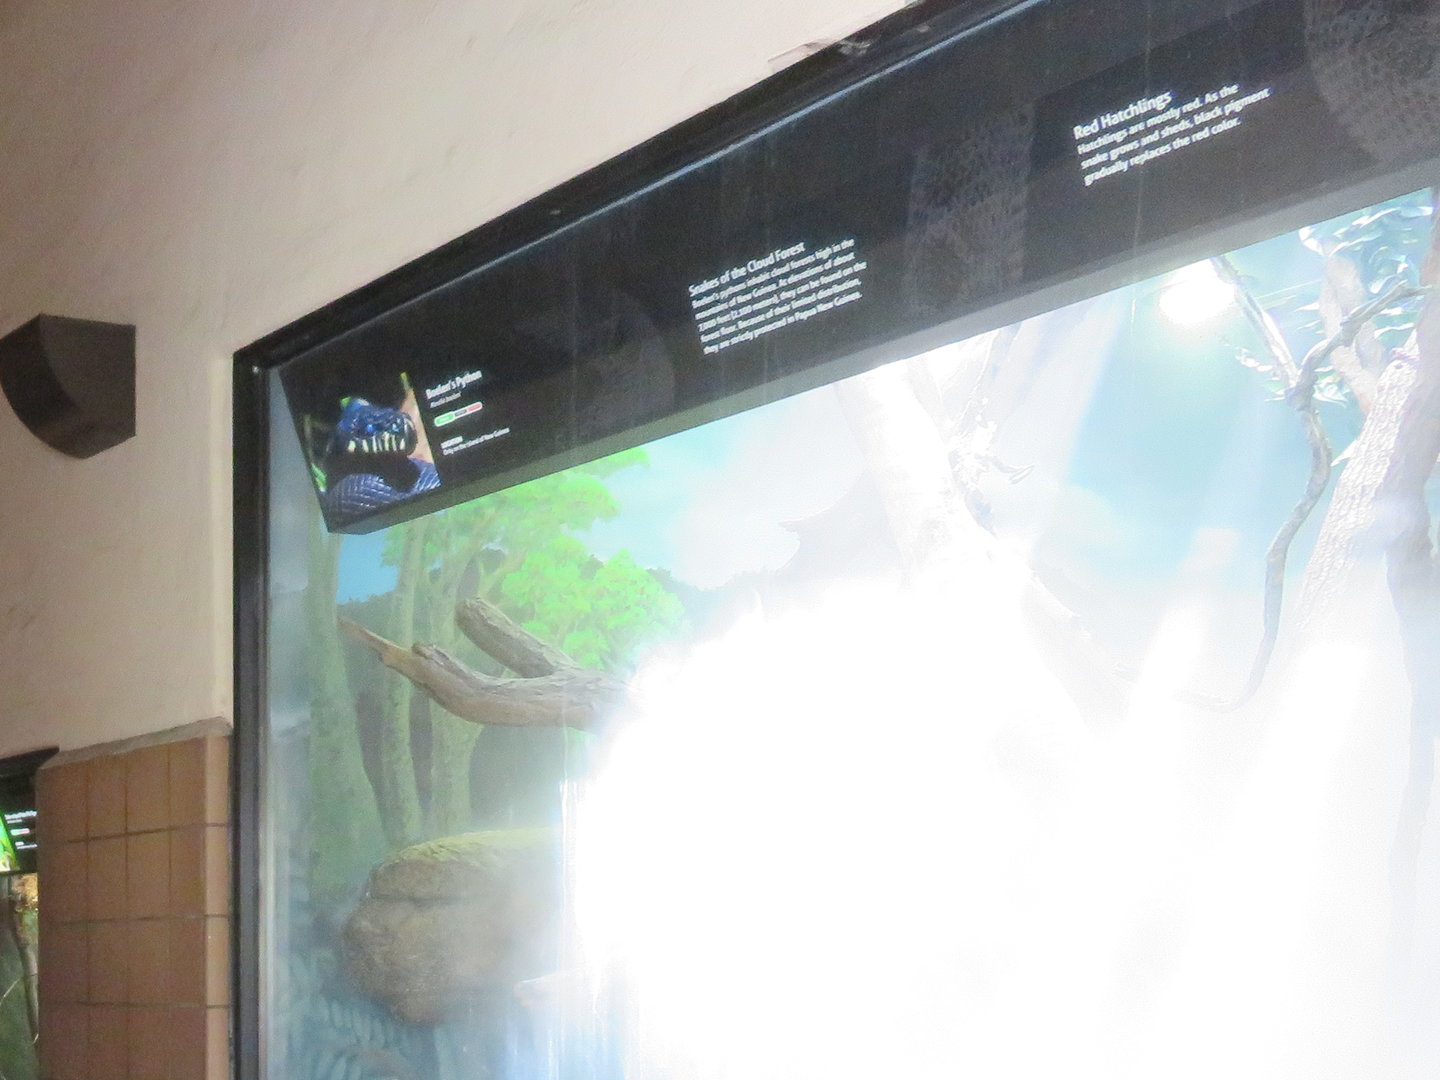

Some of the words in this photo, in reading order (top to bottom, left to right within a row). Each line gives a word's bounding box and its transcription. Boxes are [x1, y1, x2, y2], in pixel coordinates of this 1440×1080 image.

[1073, 119, 1099, 140] Red
[1100, 92, 1172, 130] Hatchlings
[1077, 129, 1128, 154] Hatchlings
[1128, 121, 1146, 135] are
[1146, 107, 1180, 127] mostly
[1181, 97, 1203, 113] red.
[1204, 92, 1219, 105] As
[1219, 84, 1239, 98] the
[1080, 152, 1108, 169] snake
[1109, 140, 1140, 161] grows
[1140, 130, 1160, 145] and
[1160, 119, 1194, 138] sheds,
[1194, 106, 1223, 125] black
[1223, 88, 1271, 116] pigment
[1084, 160, 1129, 186] gradually
[1129, 143, 1172, 165] replaces
[1172, 136, 1191, 150] the
[1191, 126, 1210, 142] red
[1210, 117, 1242, 135] color.
[688, 277, 720, 297] Snakes
[720, 269, 730, 284] of
[730, 266, 747, 280] the
[747, 252, 775, 272] Cloud
[774, 242, 806, 262] Forest
